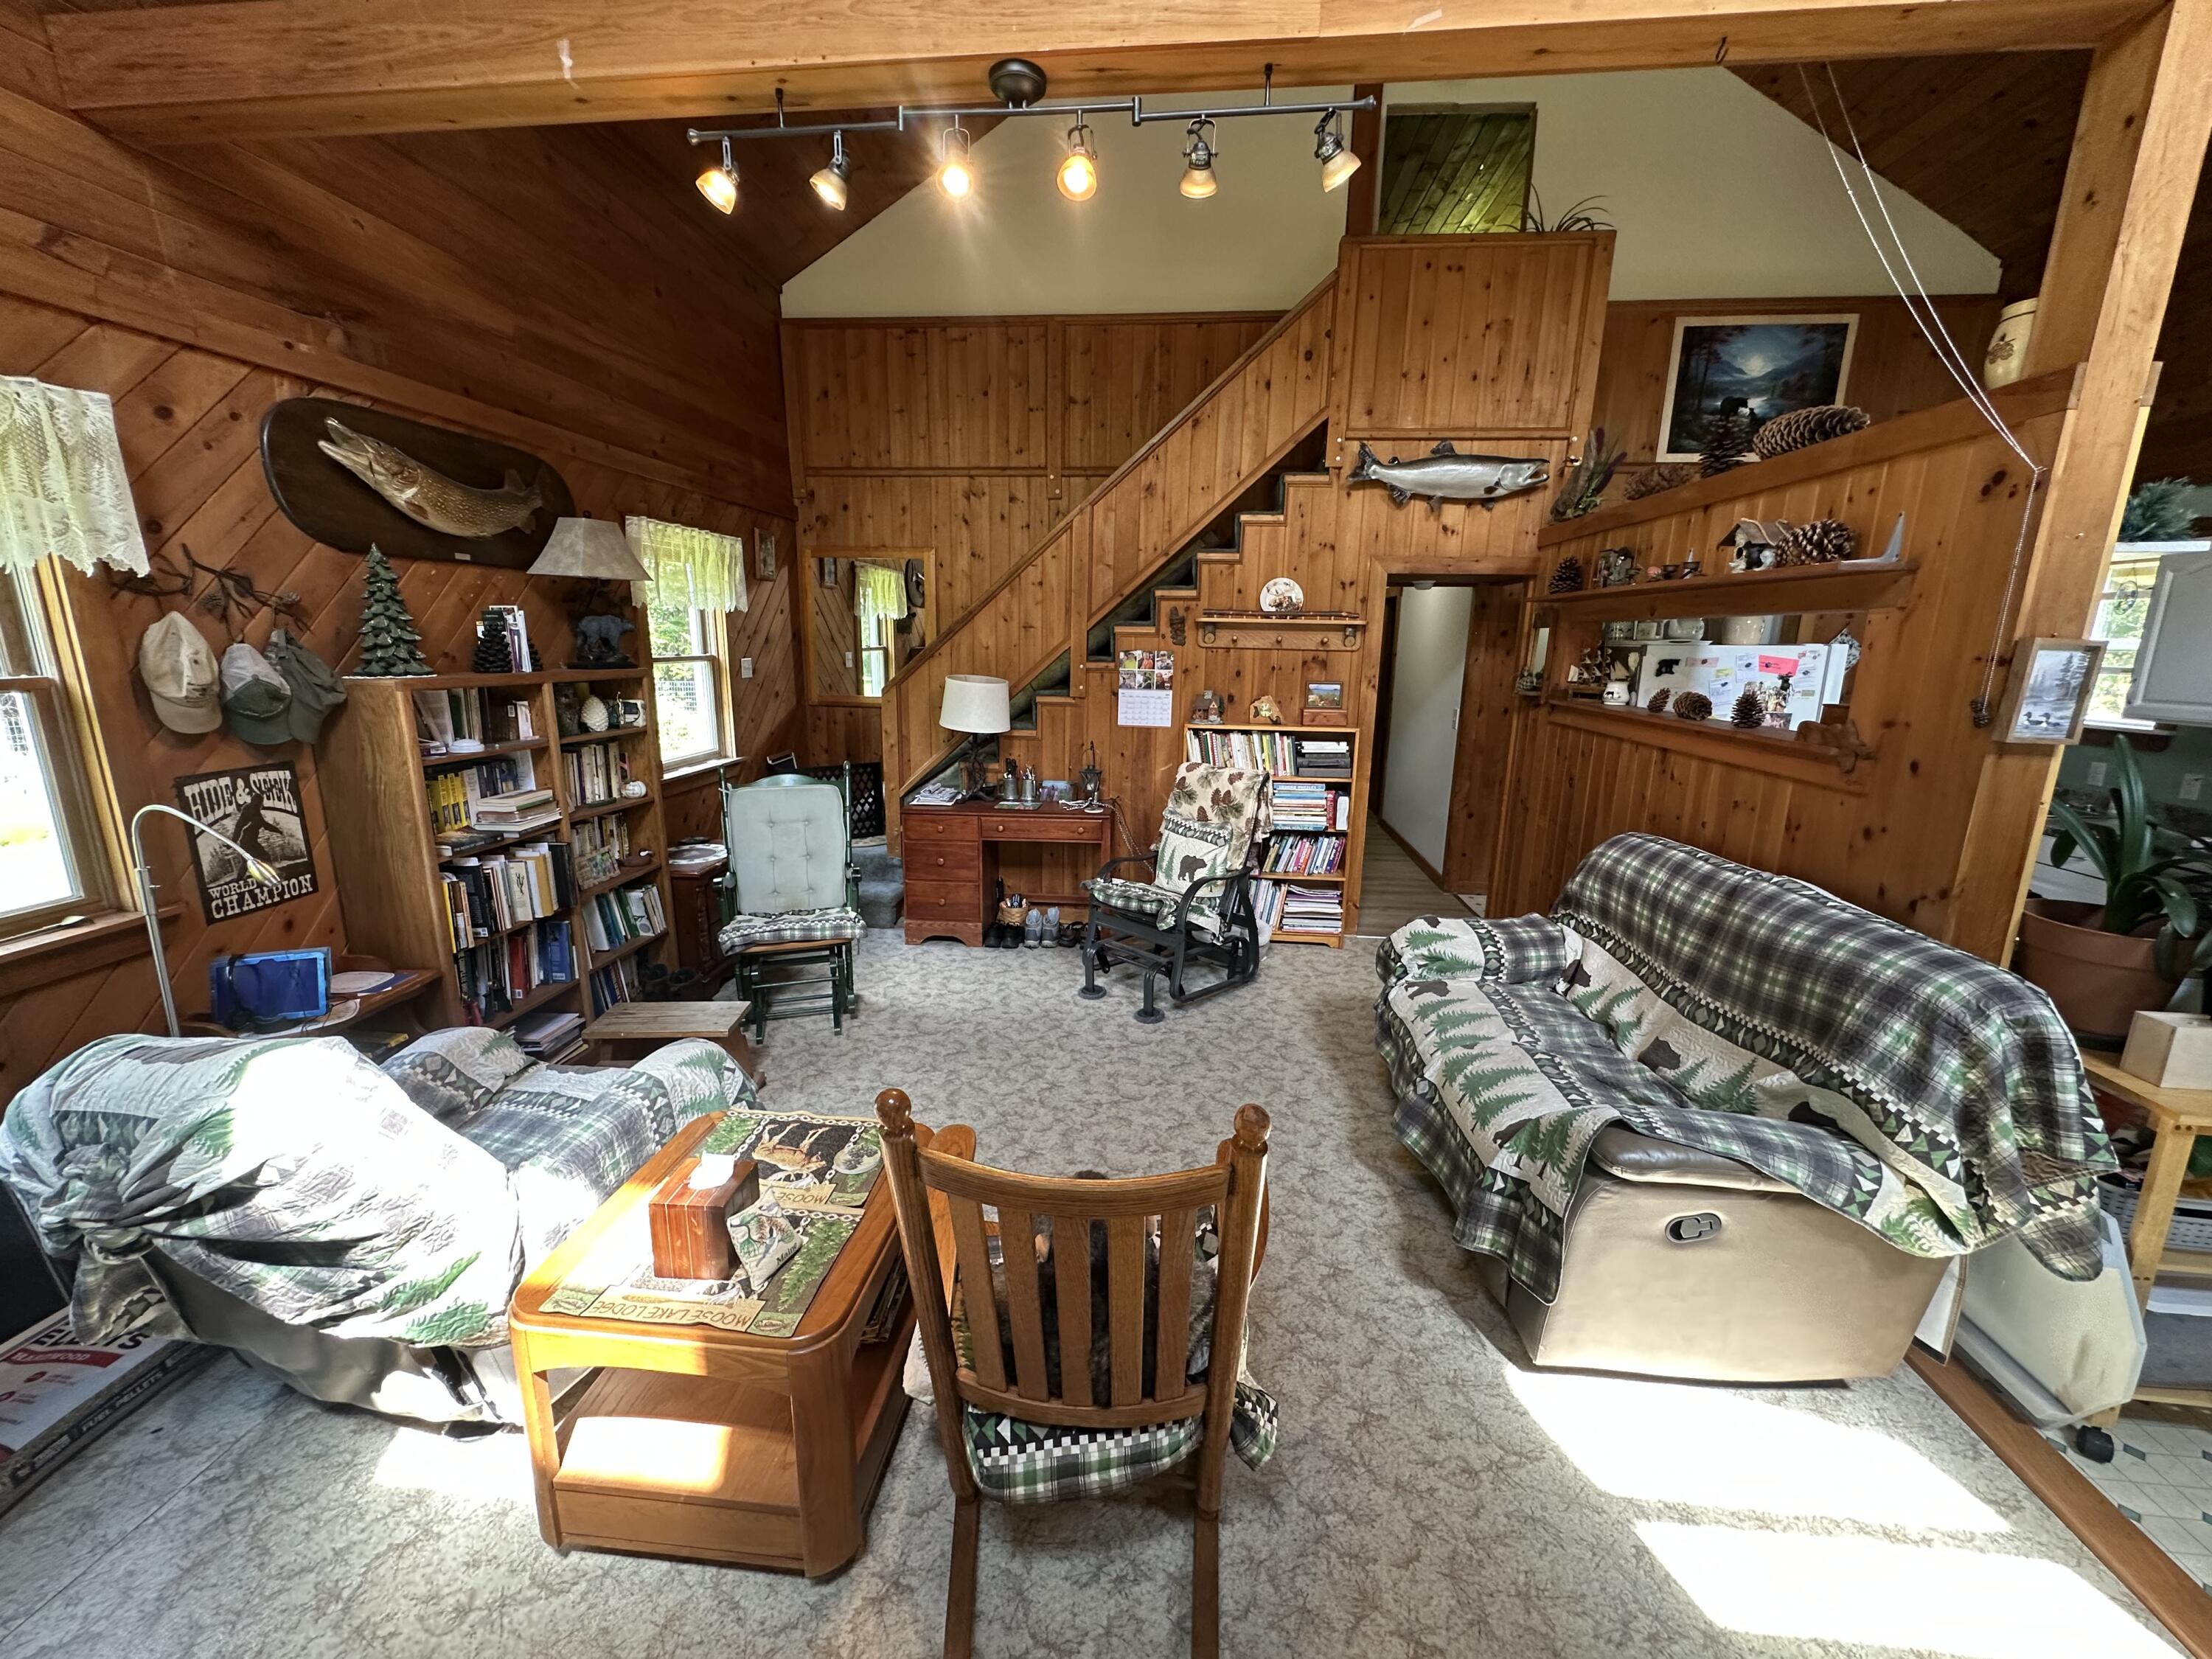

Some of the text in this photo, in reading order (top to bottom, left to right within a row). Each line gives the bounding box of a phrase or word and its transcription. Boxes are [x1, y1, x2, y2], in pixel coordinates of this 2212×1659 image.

[184, 771, 297, 832] HIDE & SEEK
[208, 878, 257, 899] WORLD
[211, 874, 313, 919] CHAMPION
[777, 1192, 827, 1205] MOOSE
[776, 1242, 797, 1266] Maine
[589, 1301, 751, 1327] MOOSE LAKE LODGE
[81, 1409, 111, 1432] FUEL
[114, 1371, 164, 1408] PELLETS
